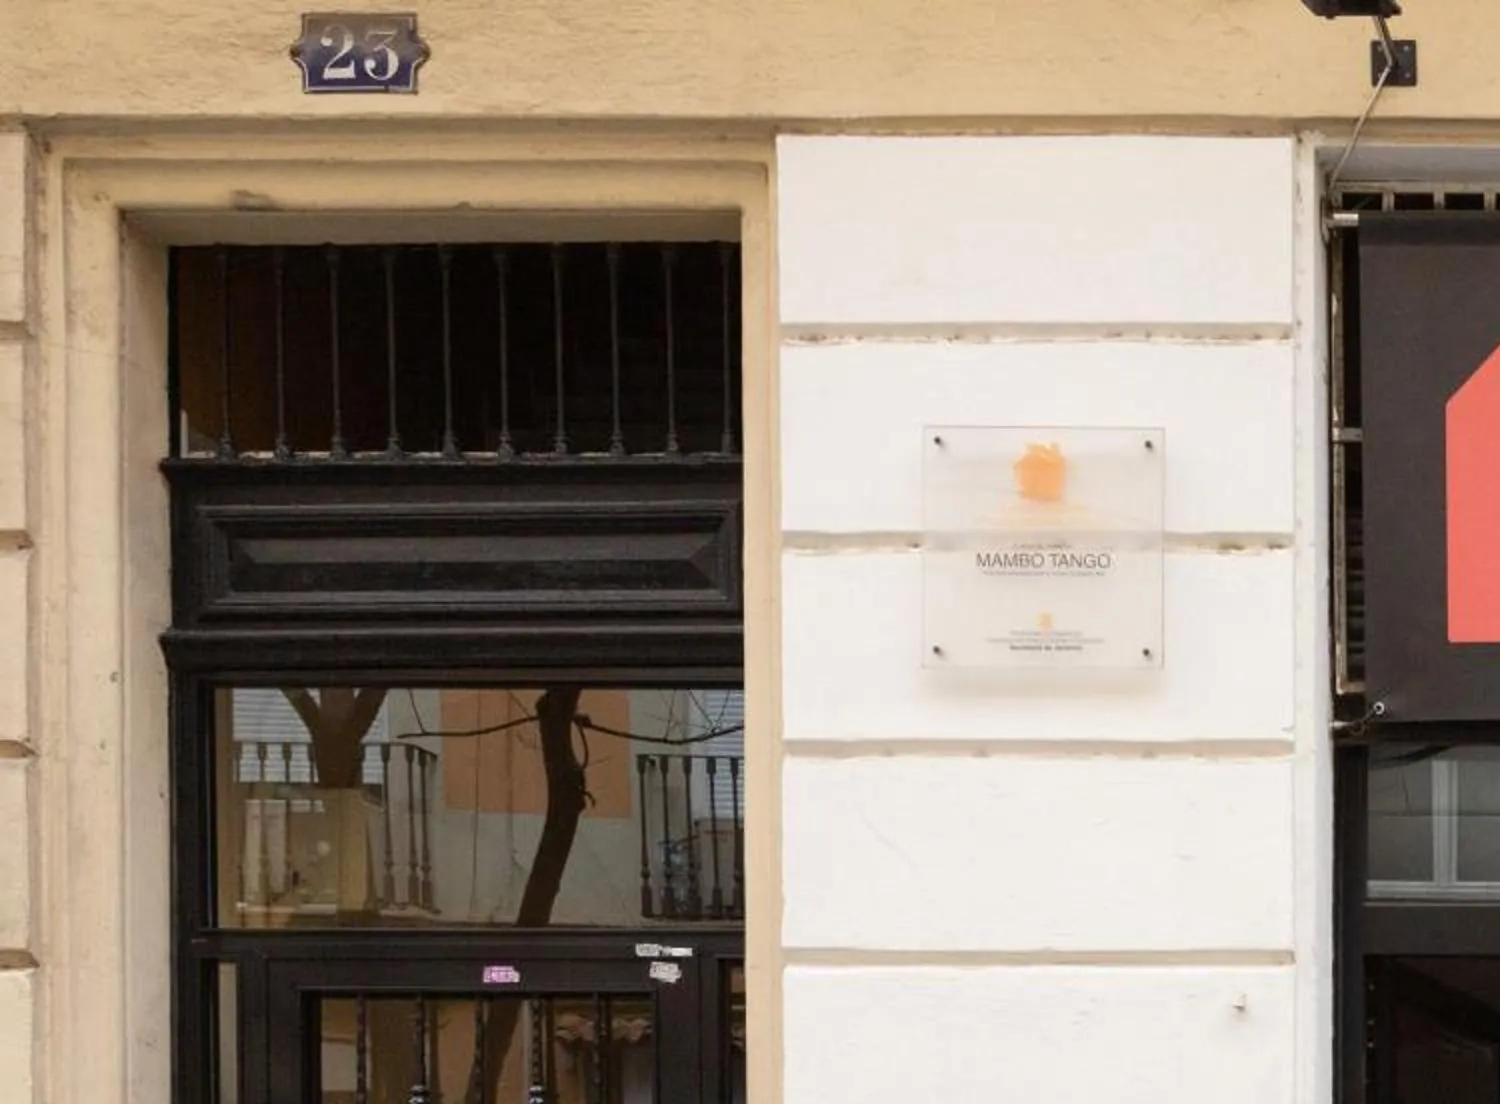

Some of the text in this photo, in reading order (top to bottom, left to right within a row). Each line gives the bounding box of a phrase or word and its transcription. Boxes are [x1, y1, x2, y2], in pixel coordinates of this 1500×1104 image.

[320, 24, 400, 81] 23
[976, 552, 1112, 569] MAMBO TANGO
